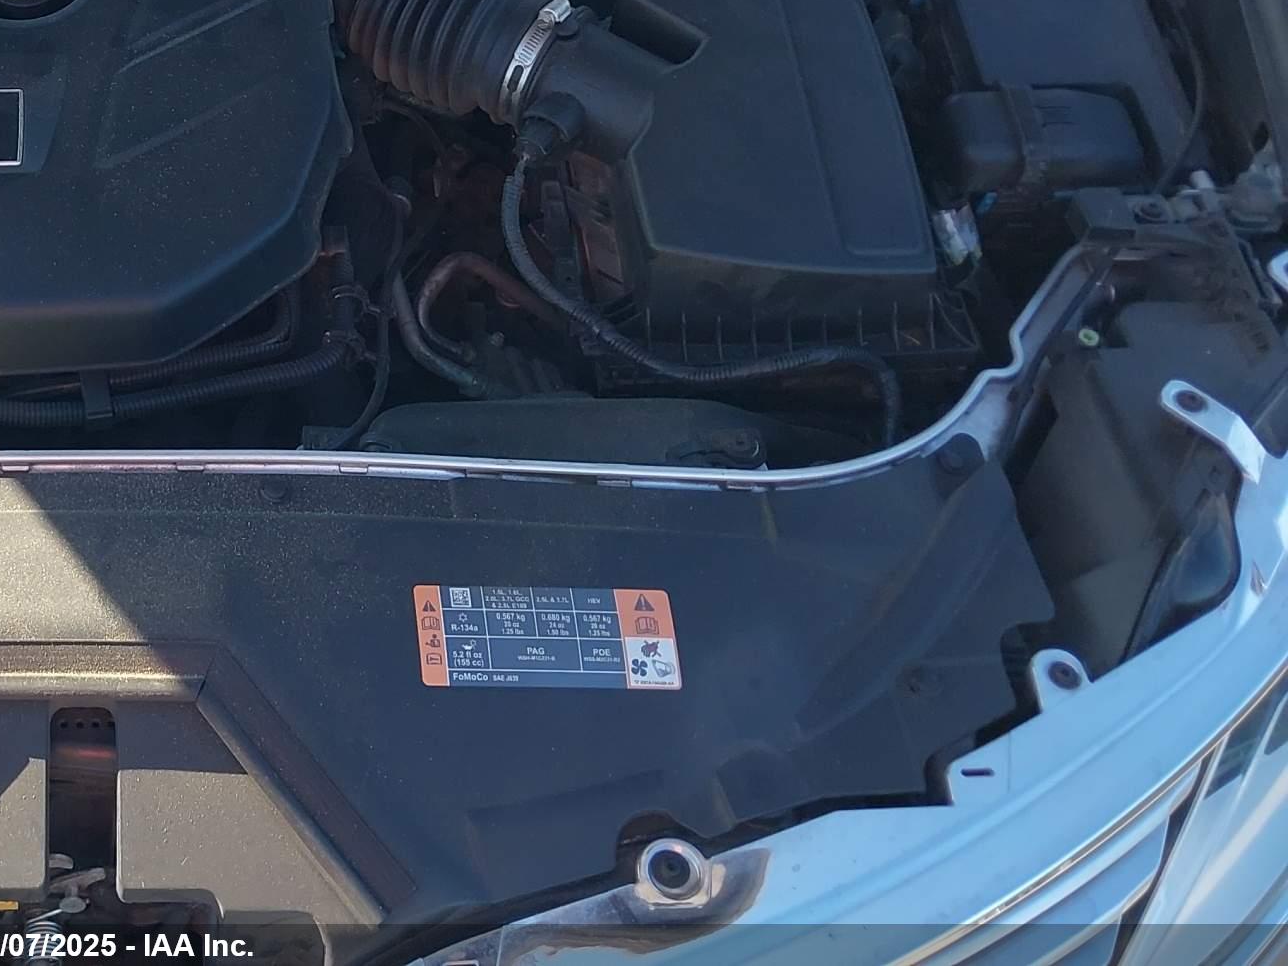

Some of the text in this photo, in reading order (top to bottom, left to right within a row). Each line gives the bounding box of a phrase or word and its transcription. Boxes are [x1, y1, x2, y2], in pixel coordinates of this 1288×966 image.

[451, 624, 479, 632] R-134a
[453, 651, 466, 659] 5.2
[527, 647, 545, 655] PAG
[454, 659, 471, 667] (155
[453, 673, 489, 682] FoMoCo
